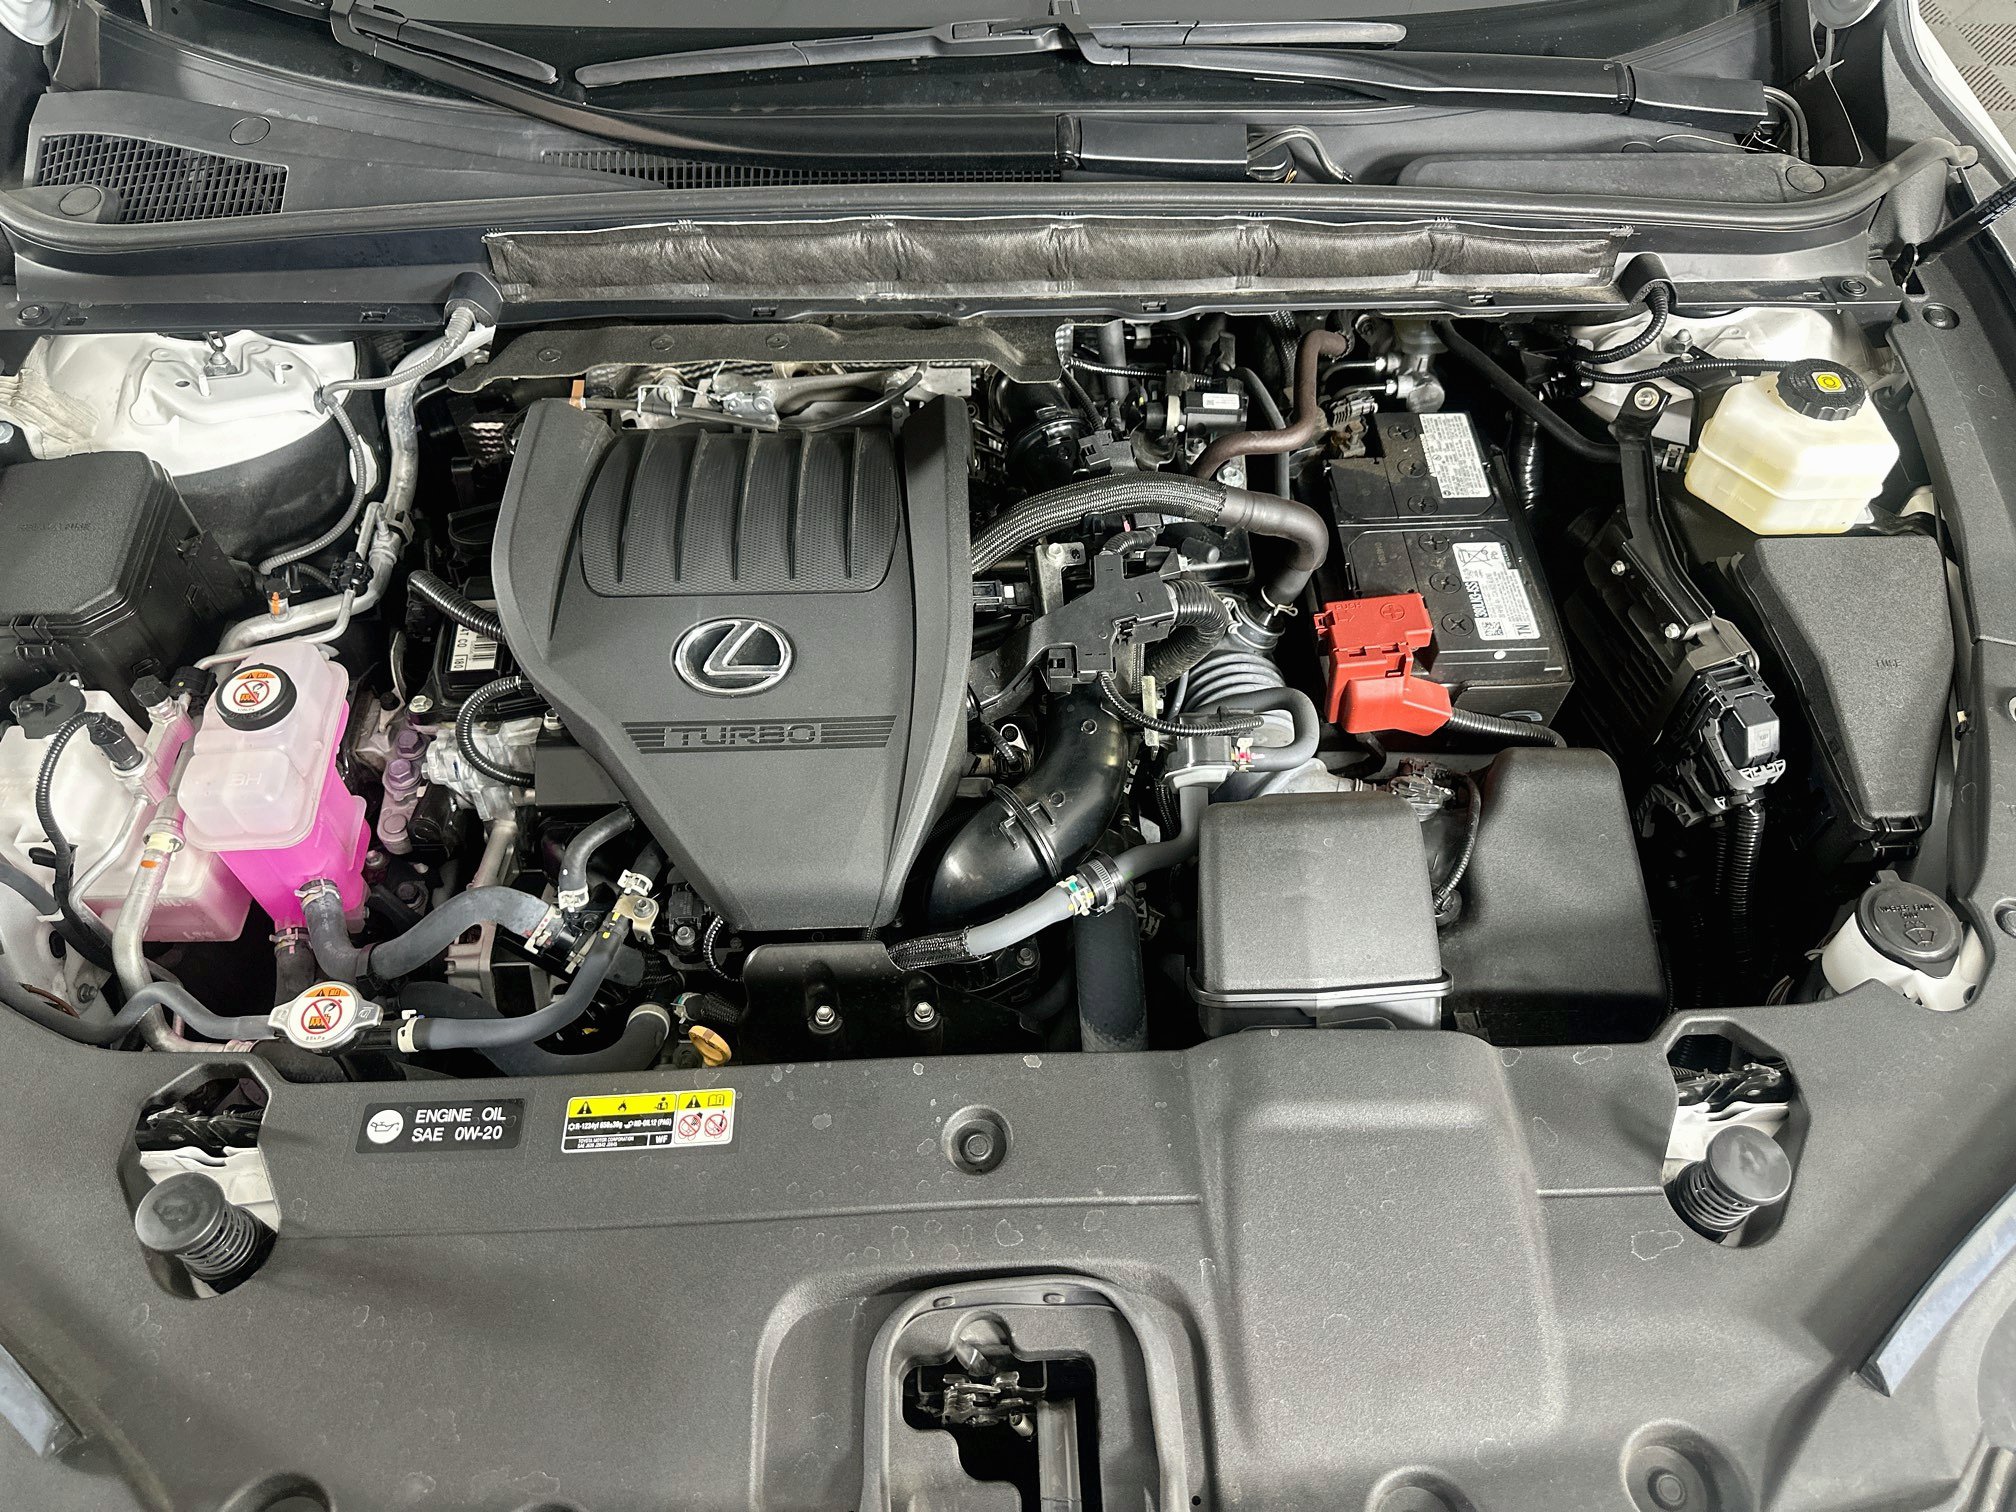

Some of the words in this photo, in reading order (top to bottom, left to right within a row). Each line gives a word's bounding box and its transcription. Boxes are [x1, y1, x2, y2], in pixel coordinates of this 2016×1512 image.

[1335, 602, 1362, 610] PUSH
[669, 724, 816, 746] TURBO
[415, 1107, 473, 1123] ENGINE
[481, 1106, 507, 1121] OIL
[411, 1127, 445, 1142] SAE
[454, 1125, 503, 1141] 0W-20
[655, 1135, 668, 1144] WF
